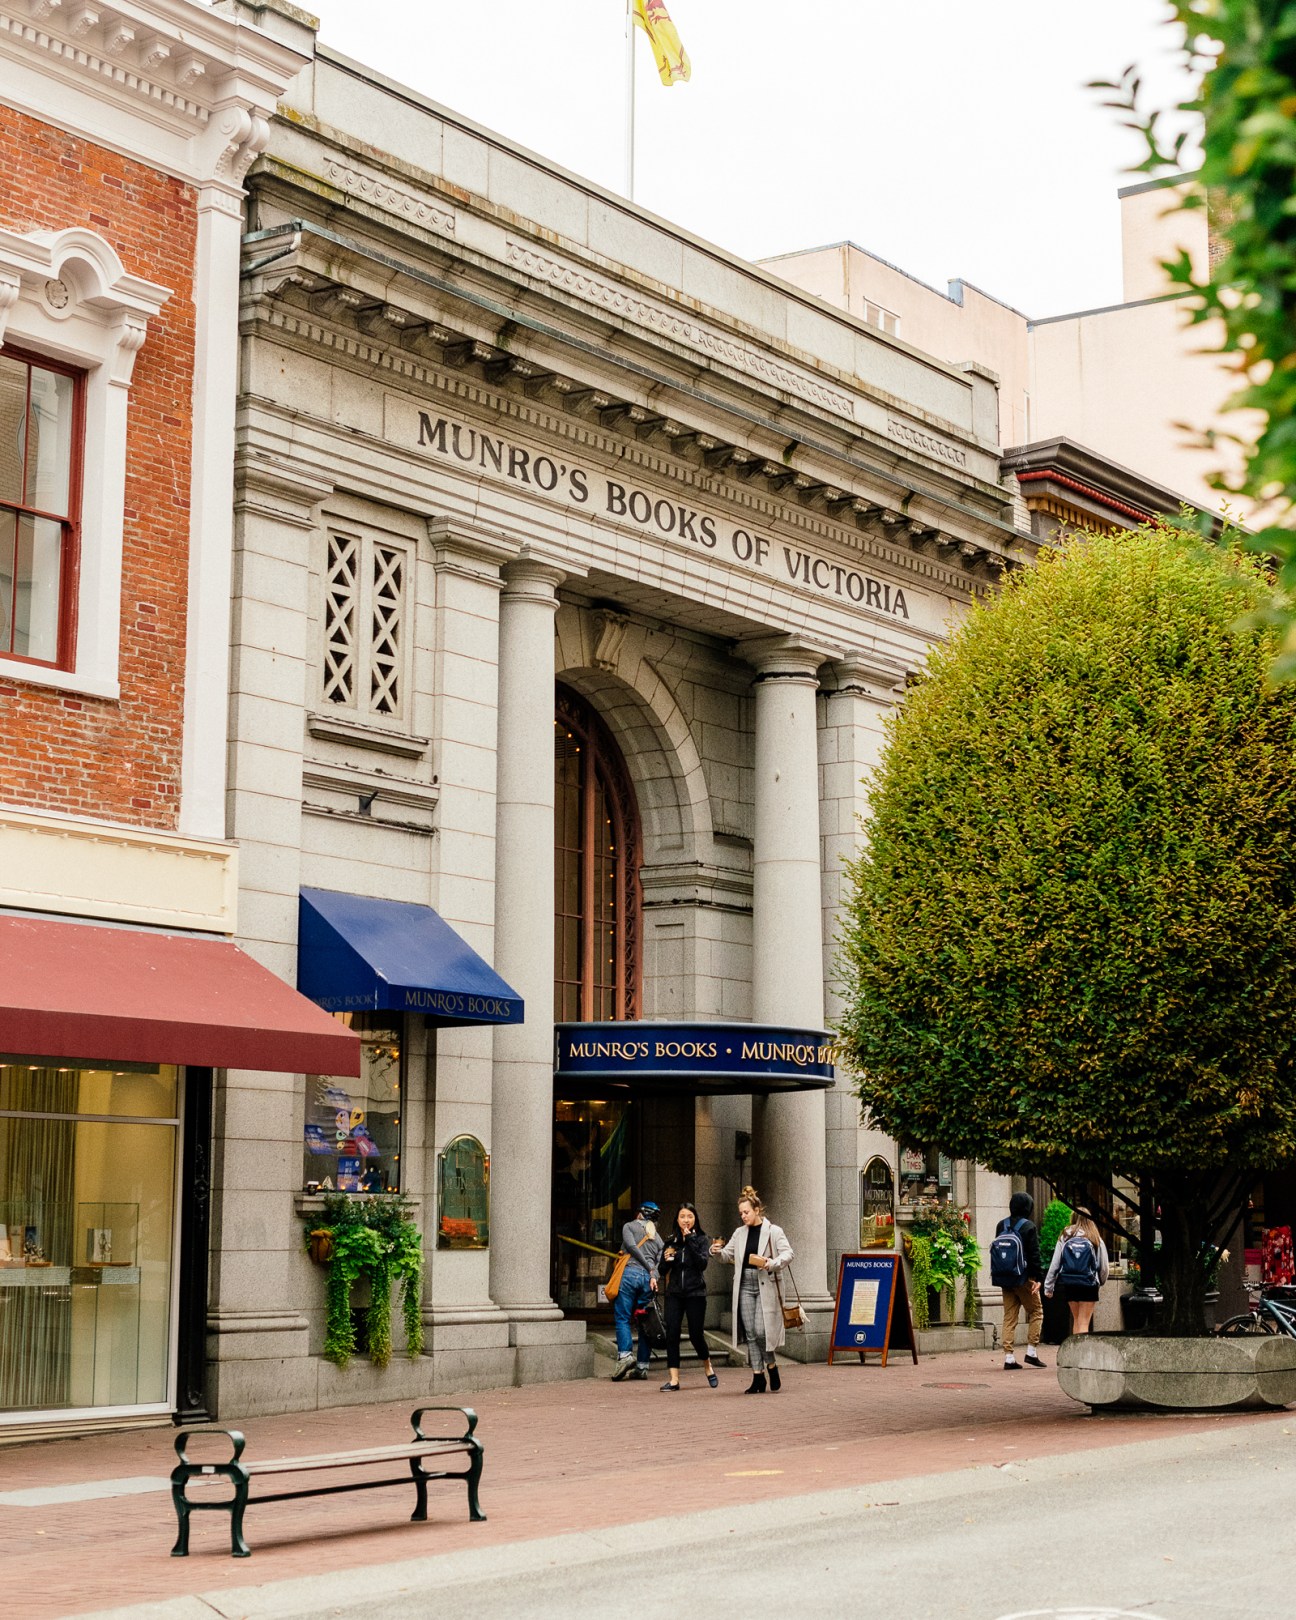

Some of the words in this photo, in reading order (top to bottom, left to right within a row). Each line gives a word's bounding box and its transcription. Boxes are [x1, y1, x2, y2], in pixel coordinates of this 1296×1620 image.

[417, 411, 589, 503] MUNRO'S
[606, 480, 717, 548] BOOKS
[732, 529, 770, 566] OF
[783, 547, 910, 619] VICTORIA
[405, 991, 464, 1014] MUNRO'S
[468, 997, 511, 1017] BOOKS
[569, 1042, 649, 1060] MUNRO'S
[655, 1042, 717, 1057] BOOKS
[741, 1041, 815, 1066] MUNRO'S
[846, 1261, 872, 1269] MUNRO'S
